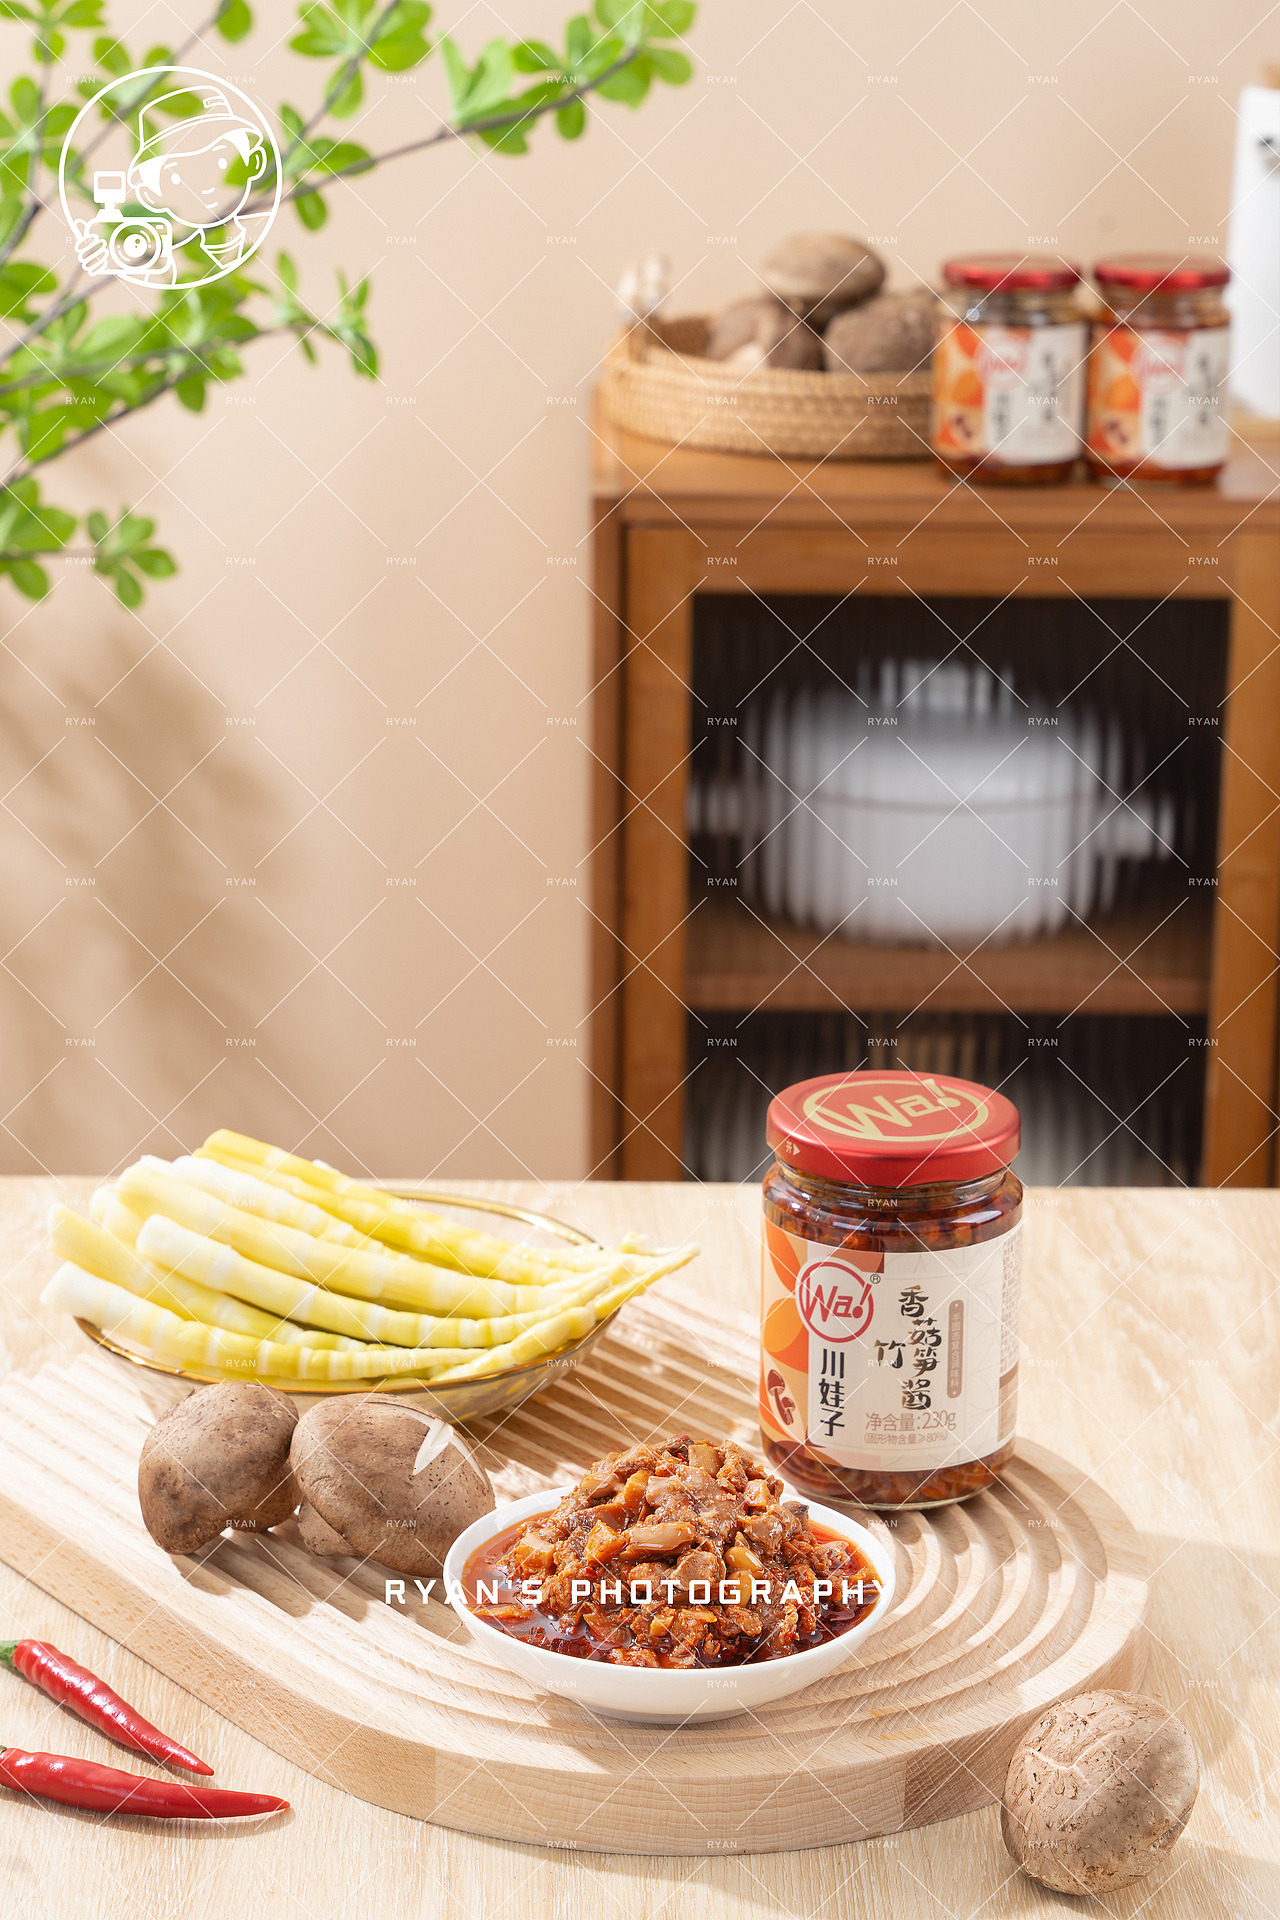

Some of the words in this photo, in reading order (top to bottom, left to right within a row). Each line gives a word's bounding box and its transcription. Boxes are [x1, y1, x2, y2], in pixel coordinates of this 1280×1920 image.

[814, 1078, 961, 1136] Wa!
[806, 1276, 872, 1322] Wa!
[818, 1348, 845, 1437] 川娃子
